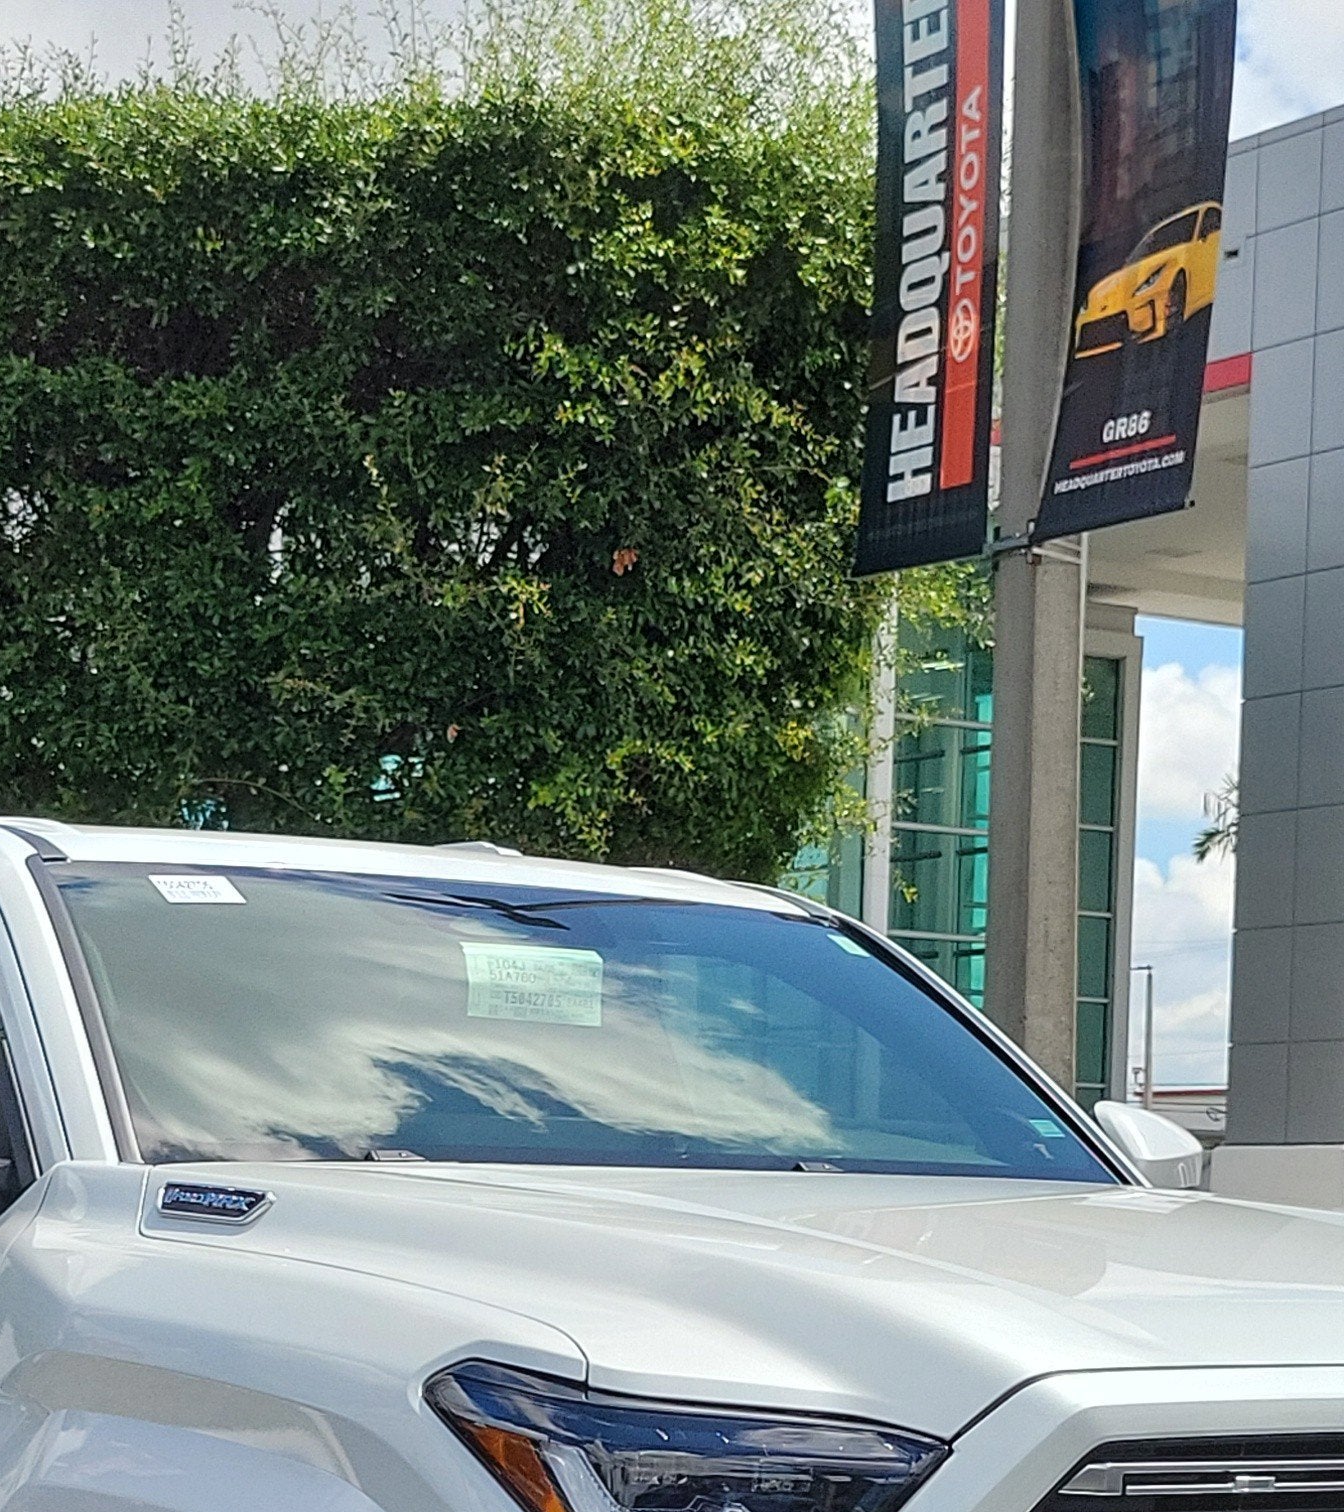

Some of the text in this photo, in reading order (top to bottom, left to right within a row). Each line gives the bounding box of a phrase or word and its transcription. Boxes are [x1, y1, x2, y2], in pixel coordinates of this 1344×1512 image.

[956, 84, 983, 296] TOYOTA
[1102, 410, 1152, 443] GR86
[1054, 450, 1186, 495] HEADQUARTERTOYOTA.COM
